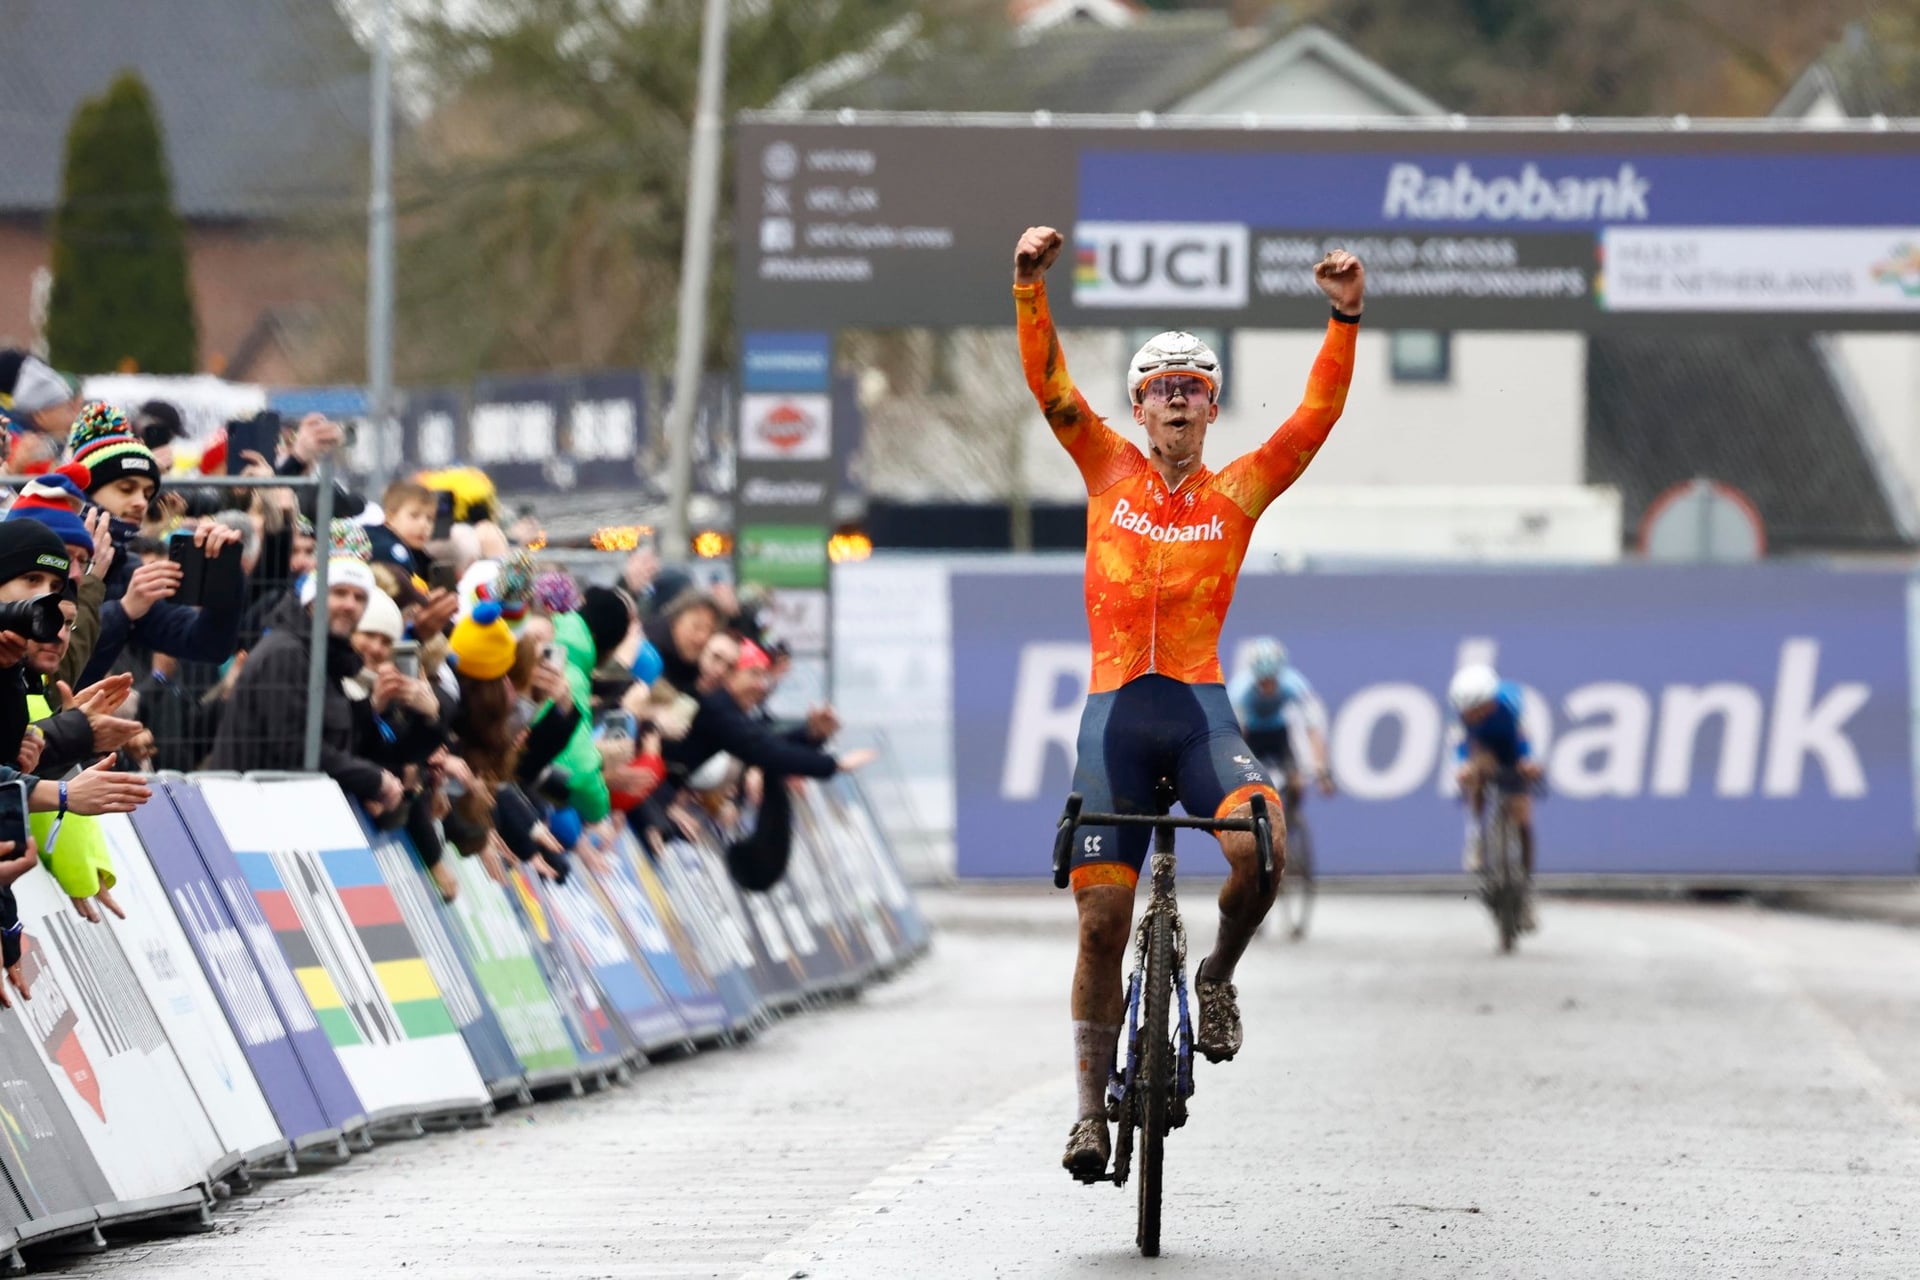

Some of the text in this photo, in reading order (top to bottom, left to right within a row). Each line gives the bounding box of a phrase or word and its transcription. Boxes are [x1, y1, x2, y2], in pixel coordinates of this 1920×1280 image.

[1383, 162, 1650, 220] Rabobank
[1110, 243, 1229, 288] UCI
[1109, 498, 1225, 543] Rabobank
